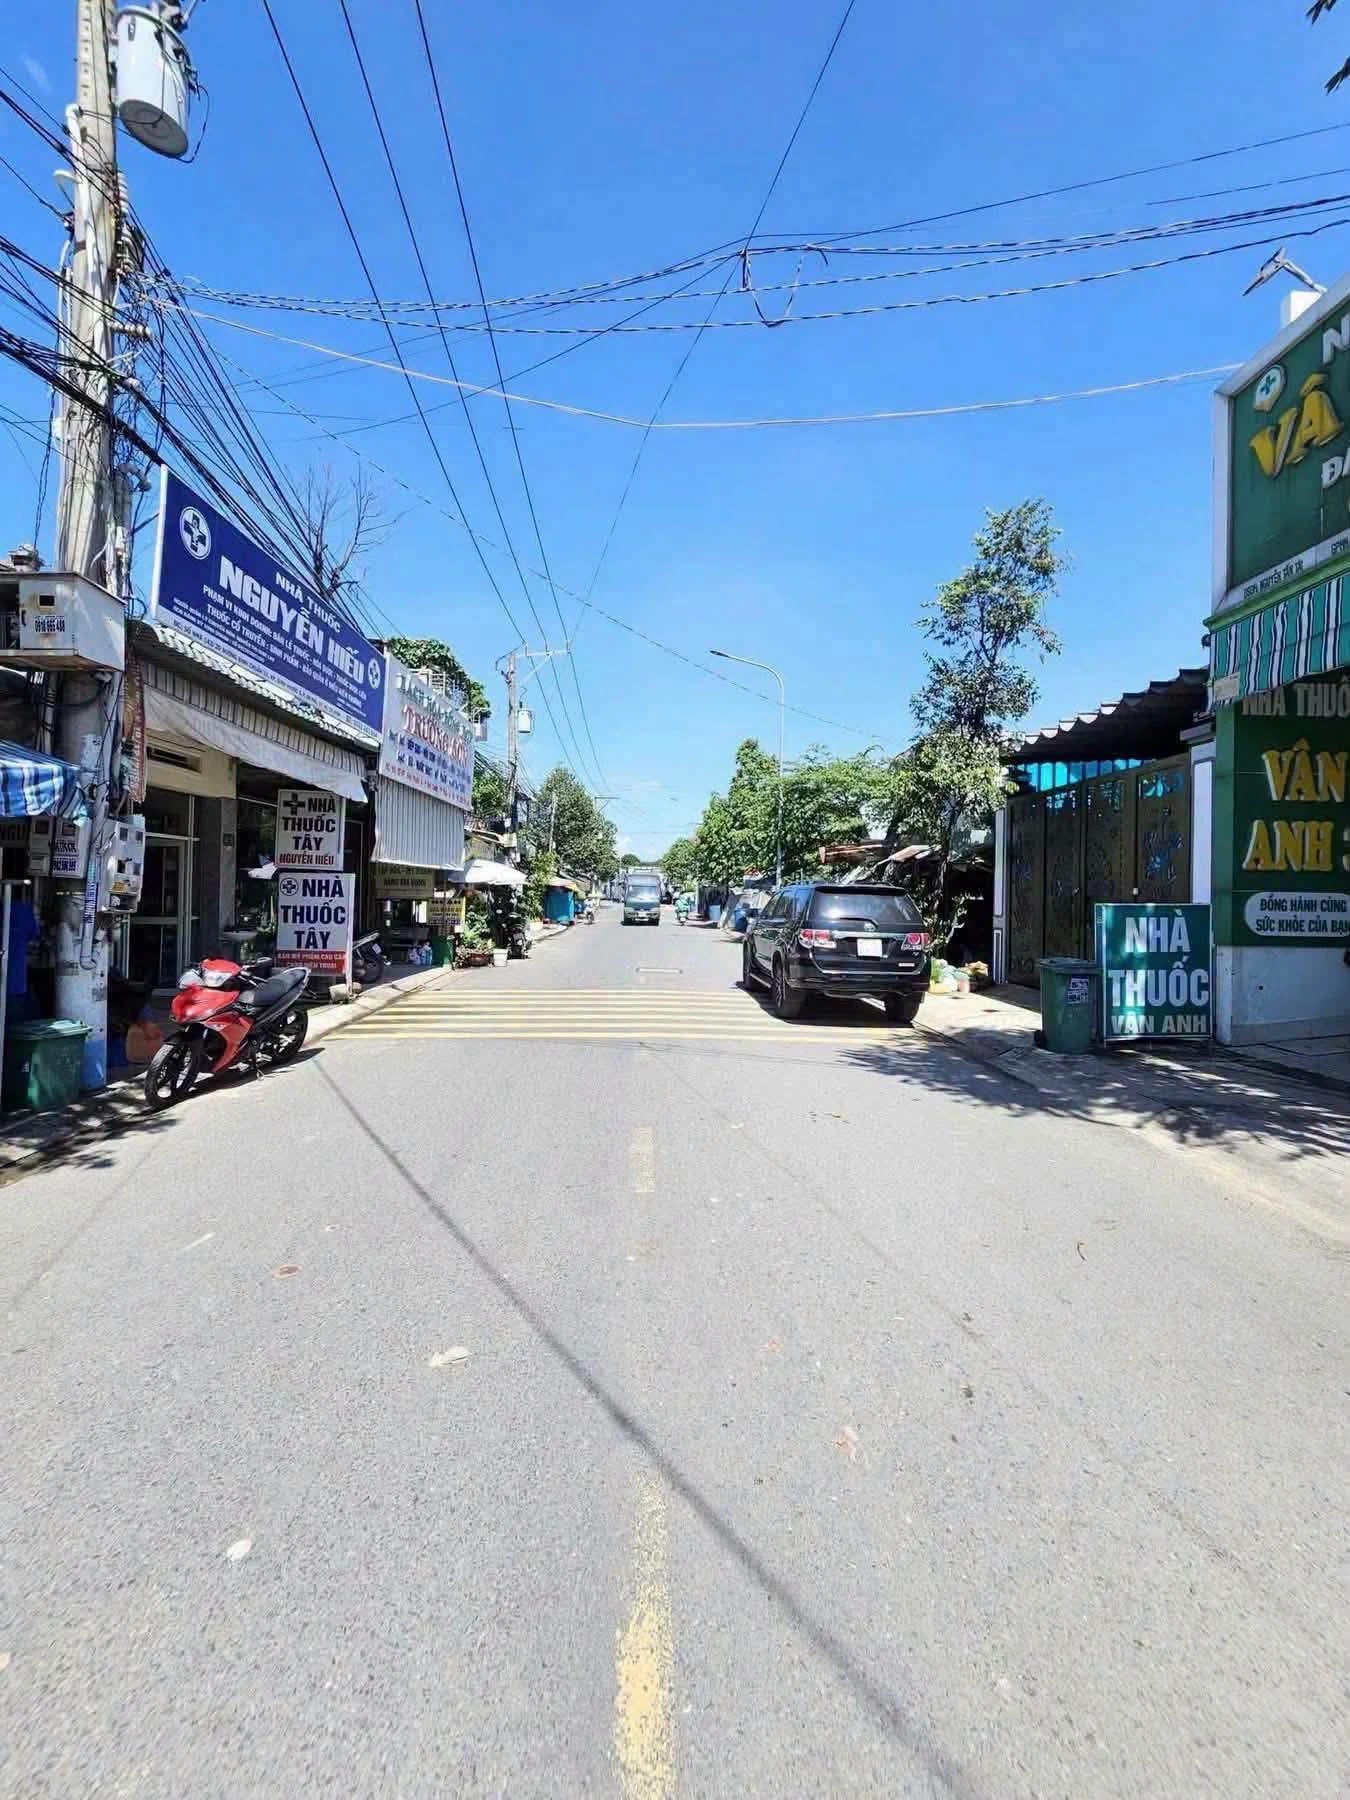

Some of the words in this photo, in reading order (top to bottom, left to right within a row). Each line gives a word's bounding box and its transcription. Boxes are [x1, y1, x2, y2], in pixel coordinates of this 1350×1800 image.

[276, 571, 304, 603] NHÀ
[307, 596, 341, 633] THUỐC
[219, 554, 324, 657] NGUYỄN
[327, 637, 365, 685] HIẾU
[1262, 738, 1347, 803] VÂN
[308, 795, 336, 813] NHÀ
[282, 813, 336, 832] THUỐC
[293, 833, 323, 851] TÂY
[1242, 819, 1334, 871] ANH
[302, 875, 344, 897] NHÀ
[280, 899, 346, 924] THUỐC
[1260, 894, 1288, 912] ĐỒNG
[1290, 896, 1317, 912] HÀNH
[1320, 896, 1347, 912] CÙNG
[294, 926, 330, 949] TÂY
[1125, 909, 1191, 953] NHÀ
[1107, 956, 1209, 1007] THUỐC
[1162, 1015, 1207, 1033] ANH
